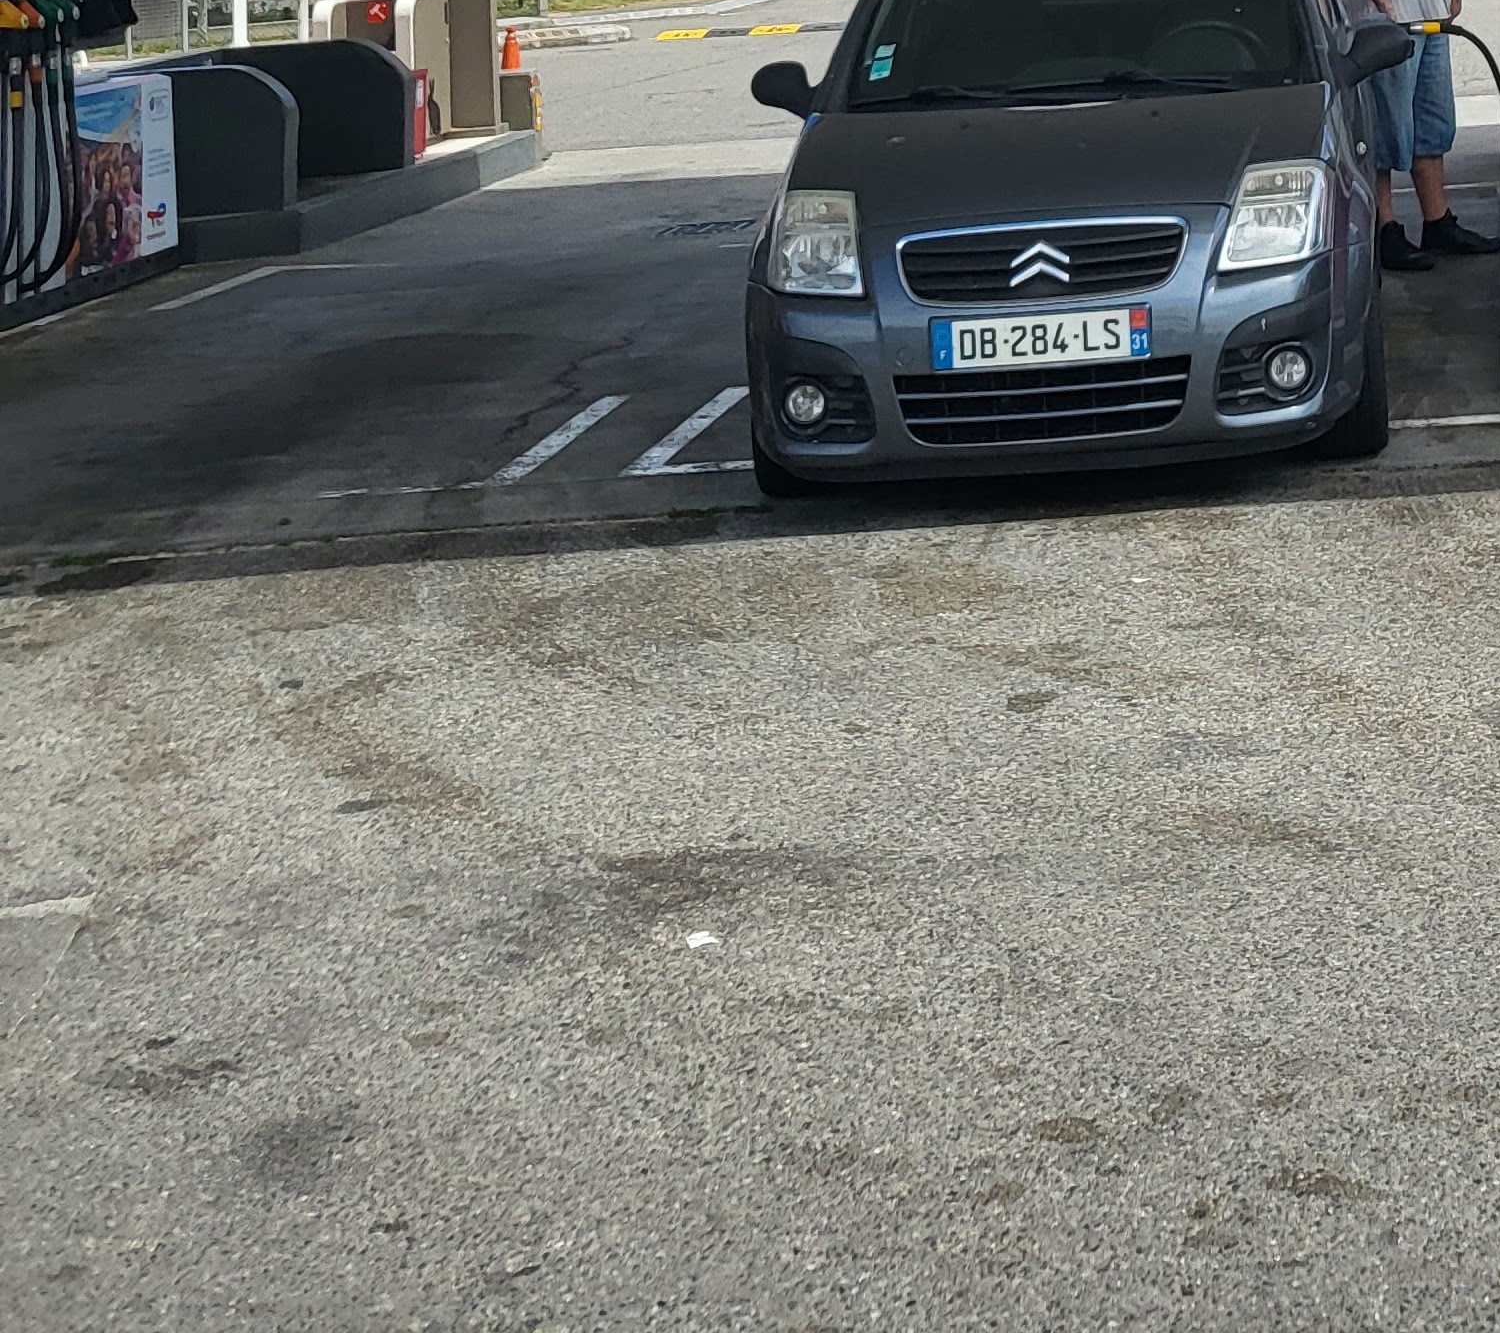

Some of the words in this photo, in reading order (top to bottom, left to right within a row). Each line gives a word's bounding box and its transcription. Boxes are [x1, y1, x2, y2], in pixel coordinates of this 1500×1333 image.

[959, 318, 1121, 361] DB-284-LS
[1132, 333, 1148, 350] 31
[939, 349, 948, 361] F
